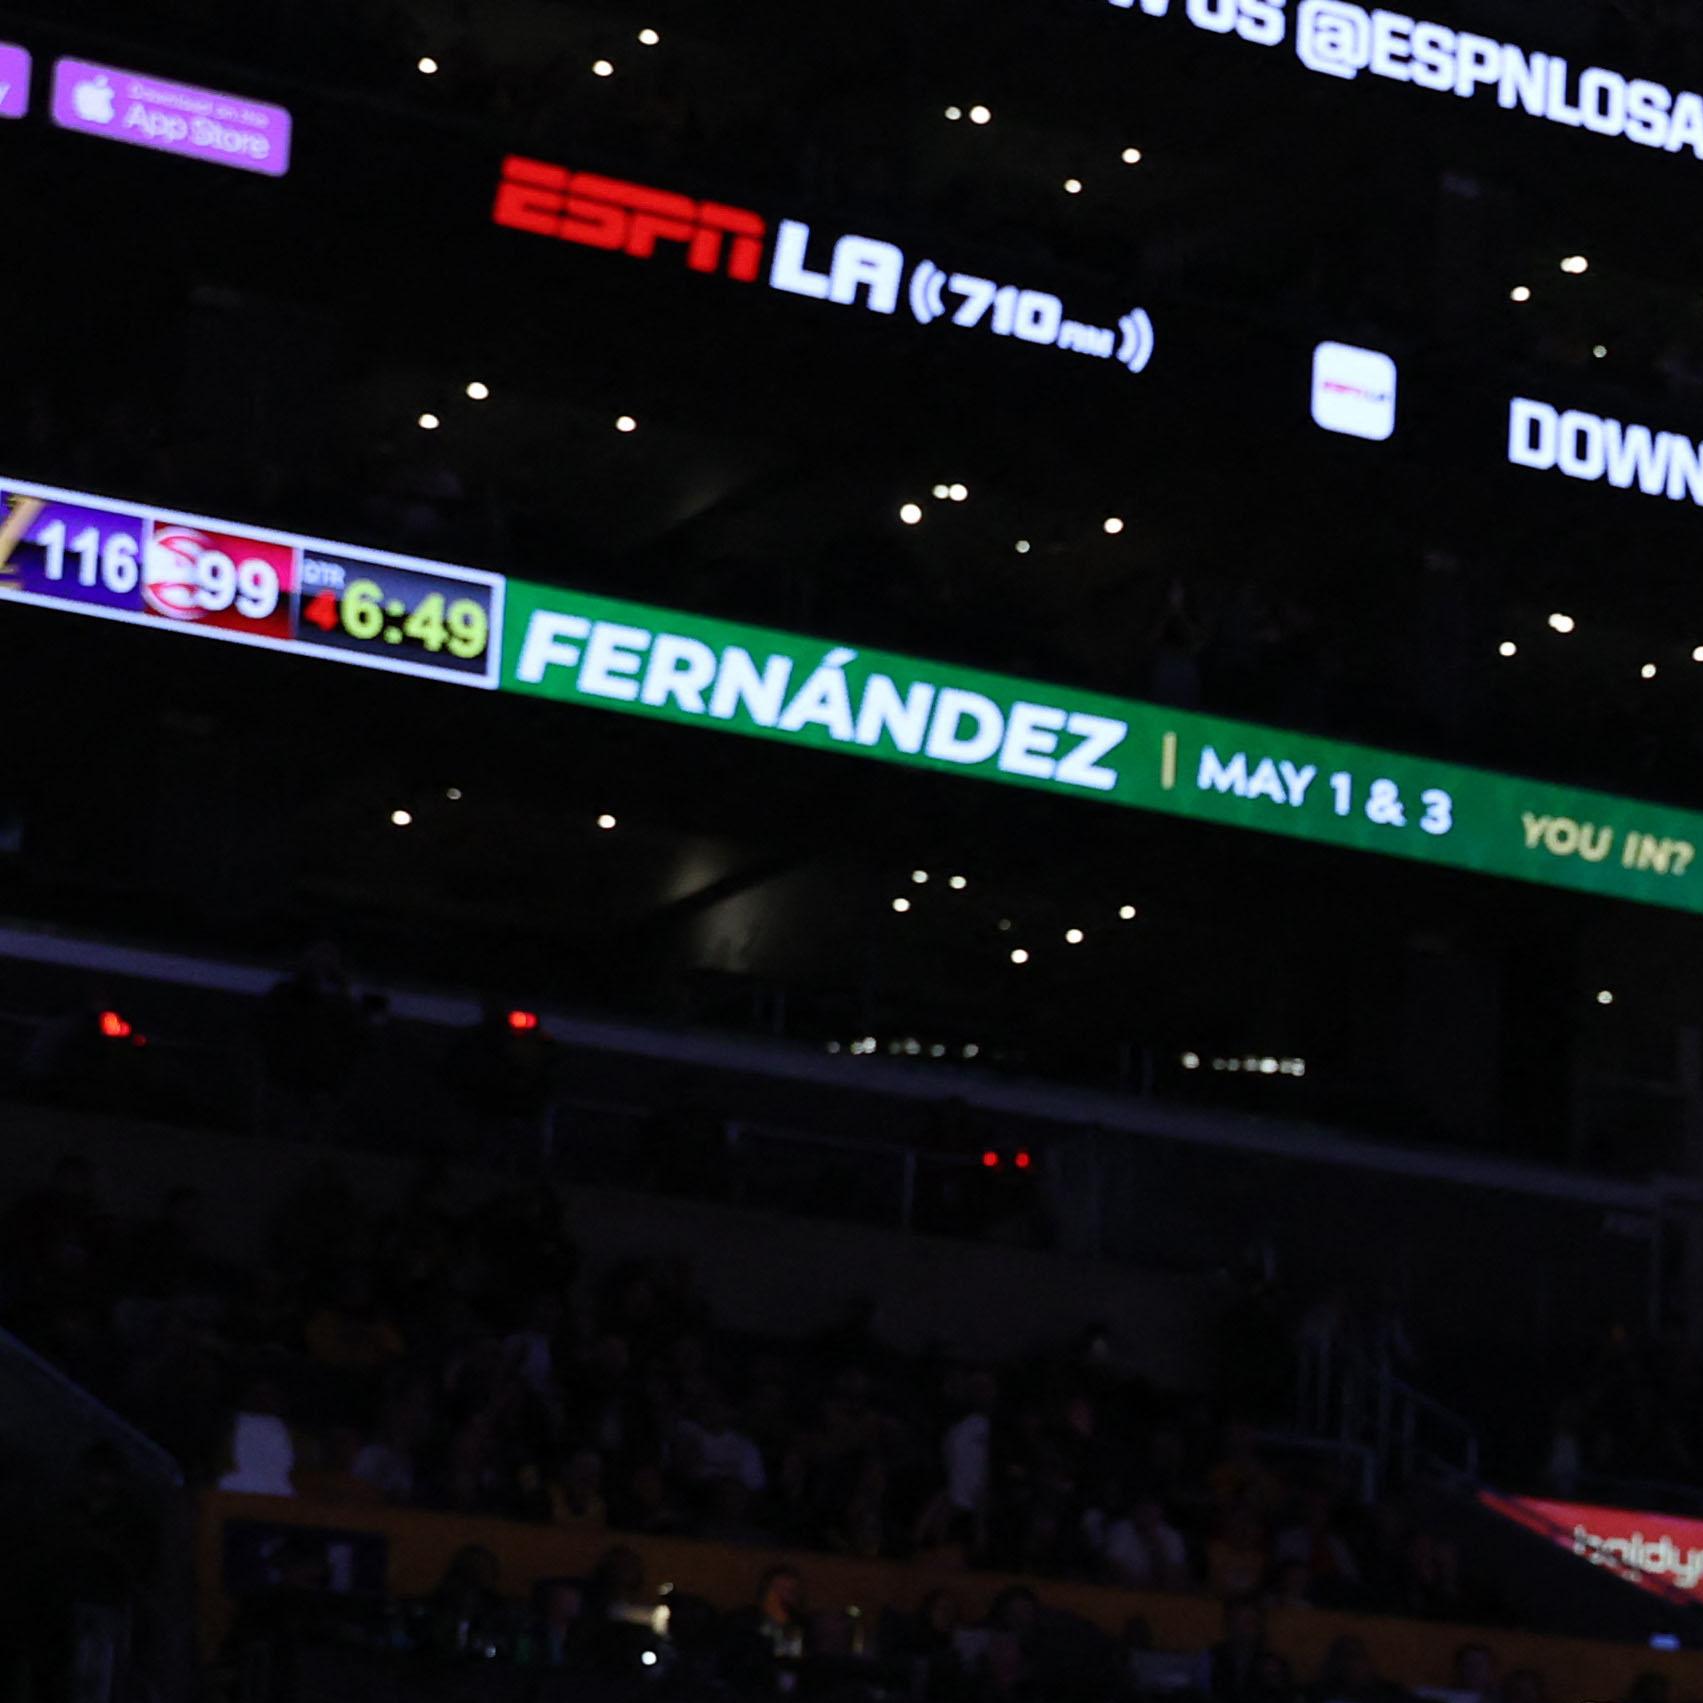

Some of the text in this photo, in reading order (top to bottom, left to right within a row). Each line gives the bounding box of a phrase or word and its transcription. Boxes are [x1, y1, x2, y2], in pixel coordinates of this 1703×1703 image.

[122, 102, 271, 160] App Store
[492, 155, 766, 283] ESPN
[769, 219, 906, 314] LA
[37, 519, 139, 594] 116
[196, 549, 280, 620] 99
[303, 578, 488, 660] 4 6:49
[516, 608, 1454, 836] FERNÁNDEZ MAY 1 & 3
[1520, 811, 1695, 876] YOU IN?
